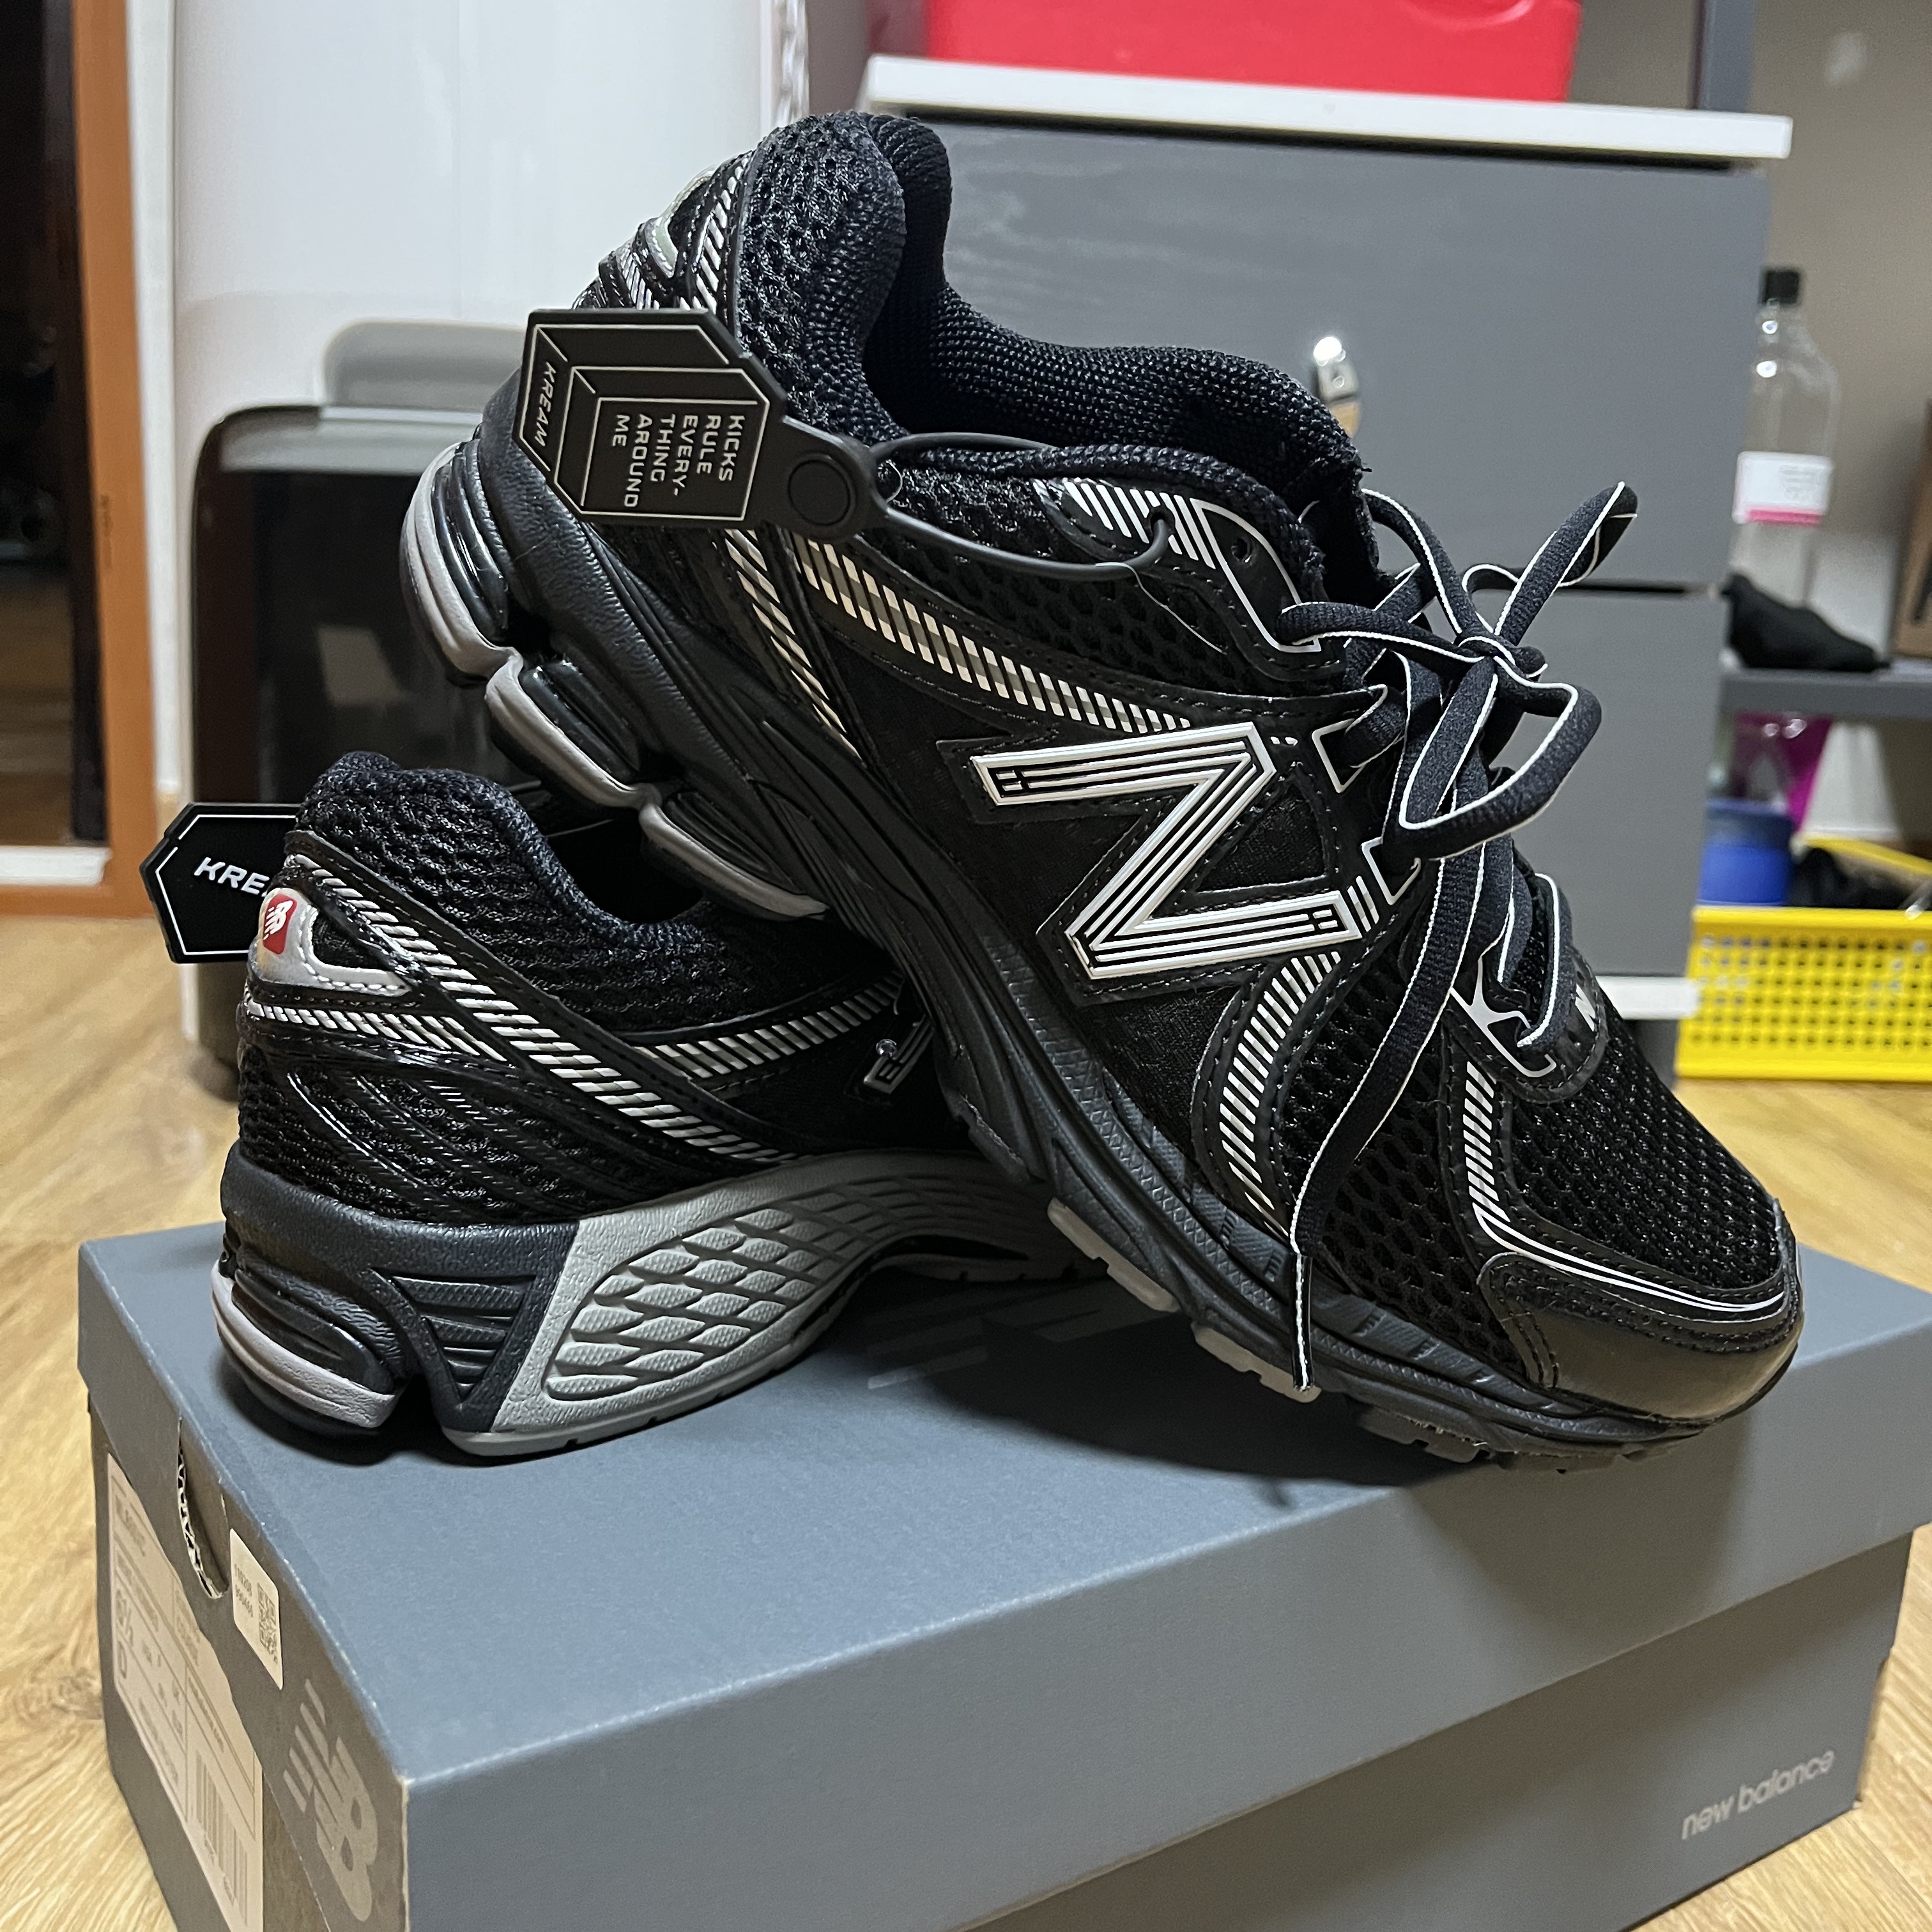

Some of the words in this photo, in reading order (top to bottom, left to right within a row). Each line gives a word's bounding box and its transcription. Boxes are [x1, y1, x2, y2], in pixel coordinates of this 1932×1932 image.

[534, 362, 556, 447] KREAM
[613, 415, 630, 447] ME
[624, 413, 652, 507] AROUND
[650, 414, 675, 482] THING
[672, 415, 698, 496] EVERY-
[696, 415, 721, 474] RULE
[719, 415, 745, 482] KICKS
[194, 857, 270, 897] KRE
[970, 722, 1361, 979] N
[1682, 1795, 1735, 1840] new
[1738, 1750, 1835, 1813] balance
